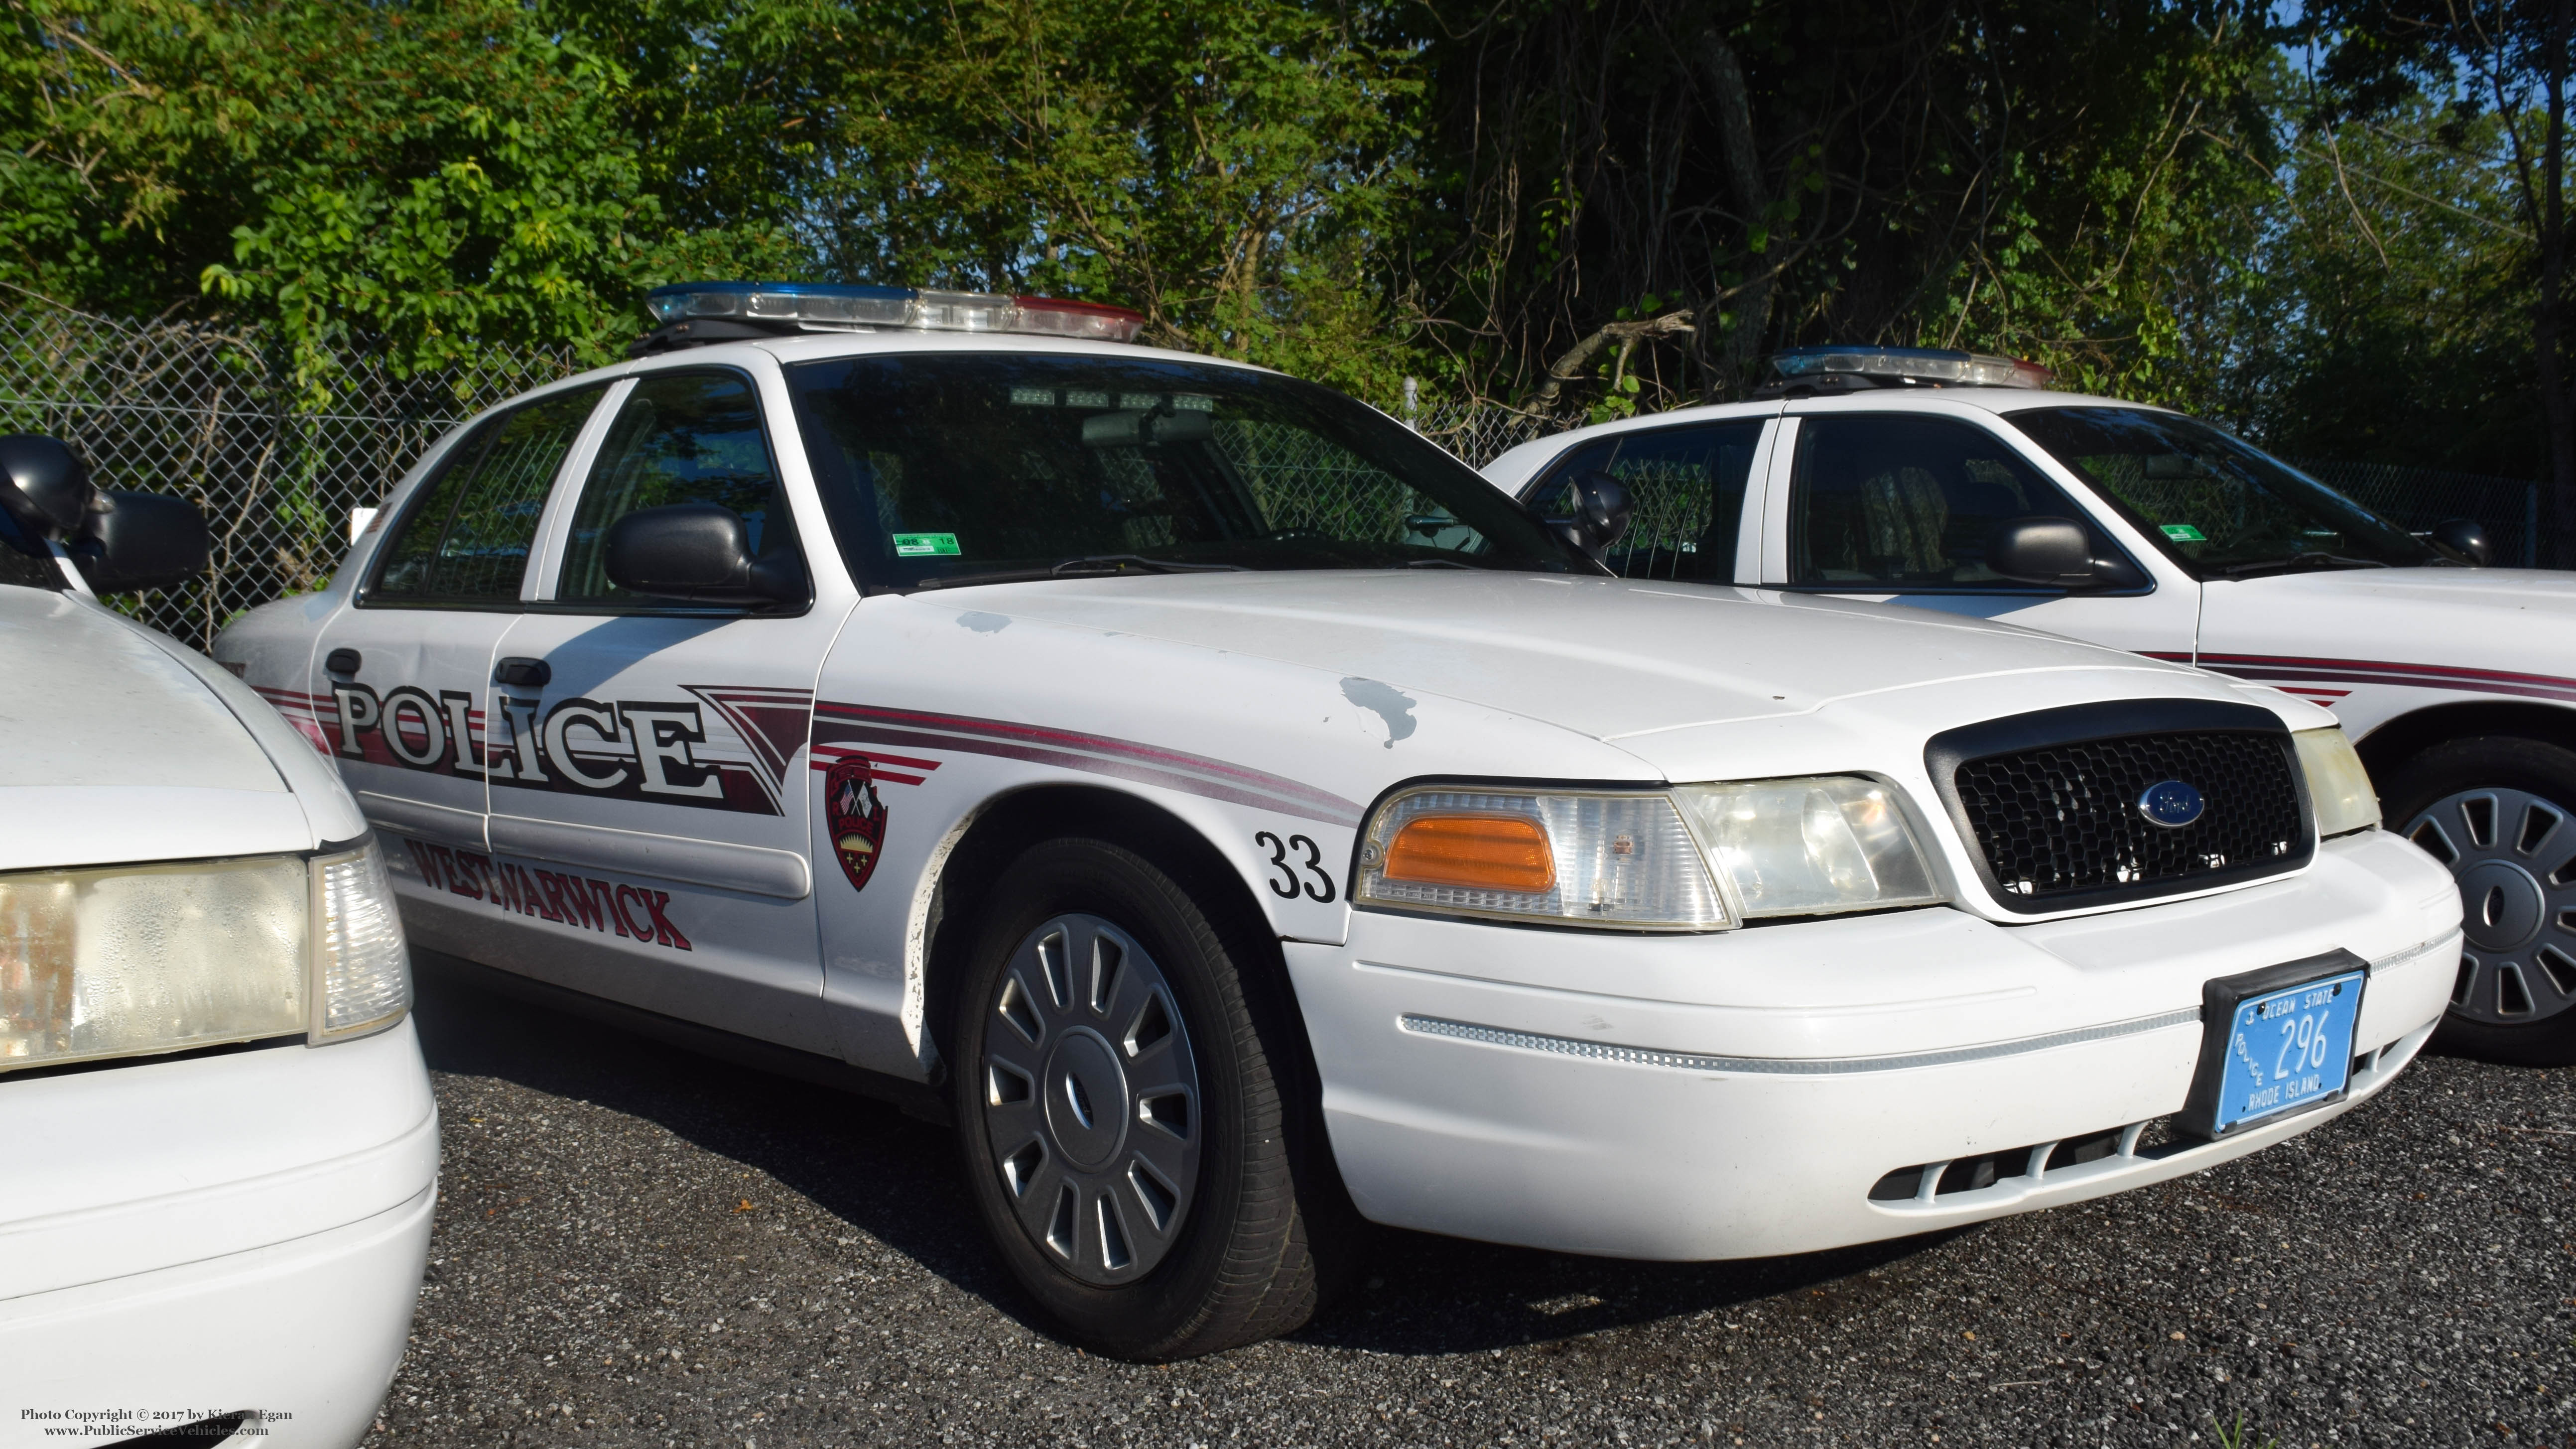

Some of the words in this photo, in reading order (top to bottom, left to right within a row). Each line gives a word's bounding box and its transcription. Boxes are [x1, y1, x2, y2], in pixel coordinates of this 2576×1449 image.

[332, 682, 725, 800] POLICE
[838, 816, 873, 834] POLICE
[1255, 831, 1336, 903] 33
[2262, 998, 2296, 1021] OCEAN
[2303, 989, 2333, 1010] STATE
[2235, 1033, 2264, 1087] POLICE
[2274, 1010, 2329, 1081] 296
[2248, 1086, 2280, 1111] RHODE
[2285, 1075, 2319, 1100] ISLAND
